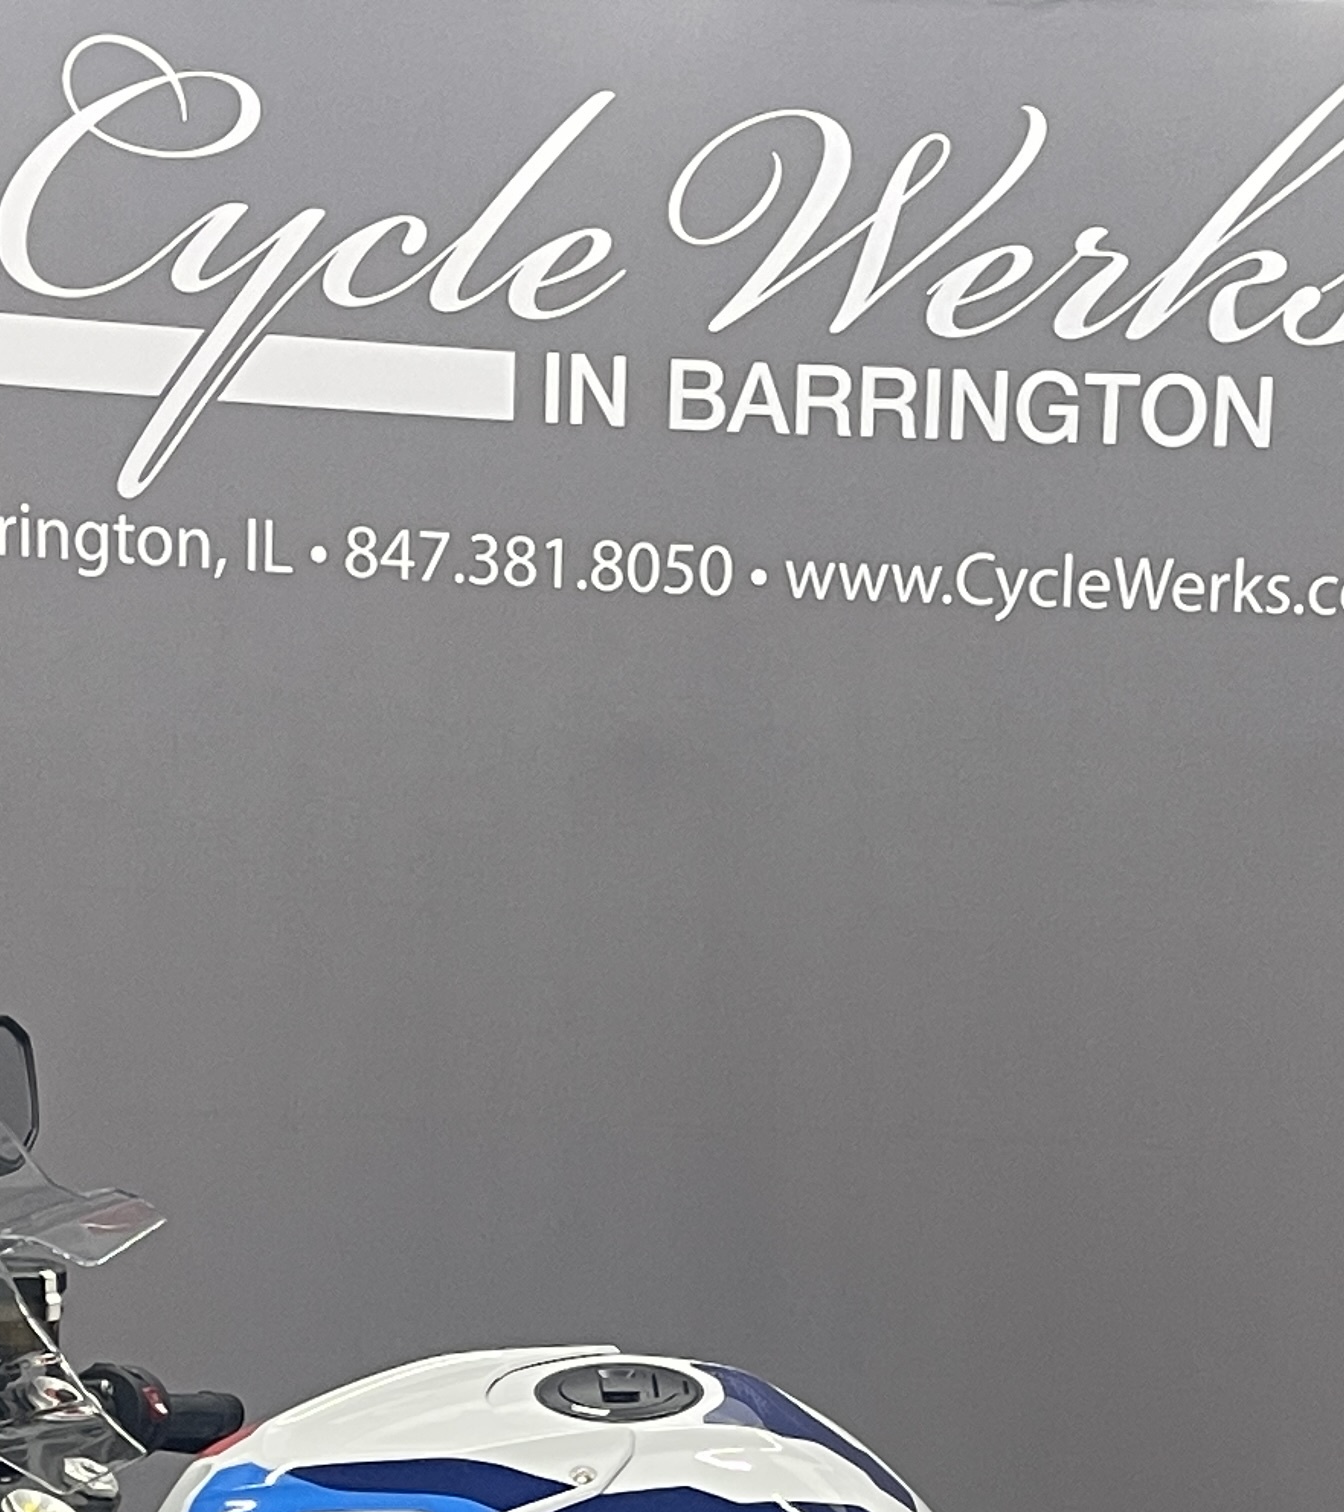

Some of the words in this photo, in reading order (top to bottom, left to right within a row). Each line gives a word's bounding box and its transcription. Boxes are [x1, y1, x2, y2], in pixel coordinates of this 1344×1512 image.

[545, 351, 627, 428] IN
[668, 358, 1274, 448] BARRINGTON
[247, 517, 294, 574] IL
[344, 525, 733, 597] 847.381.8050
